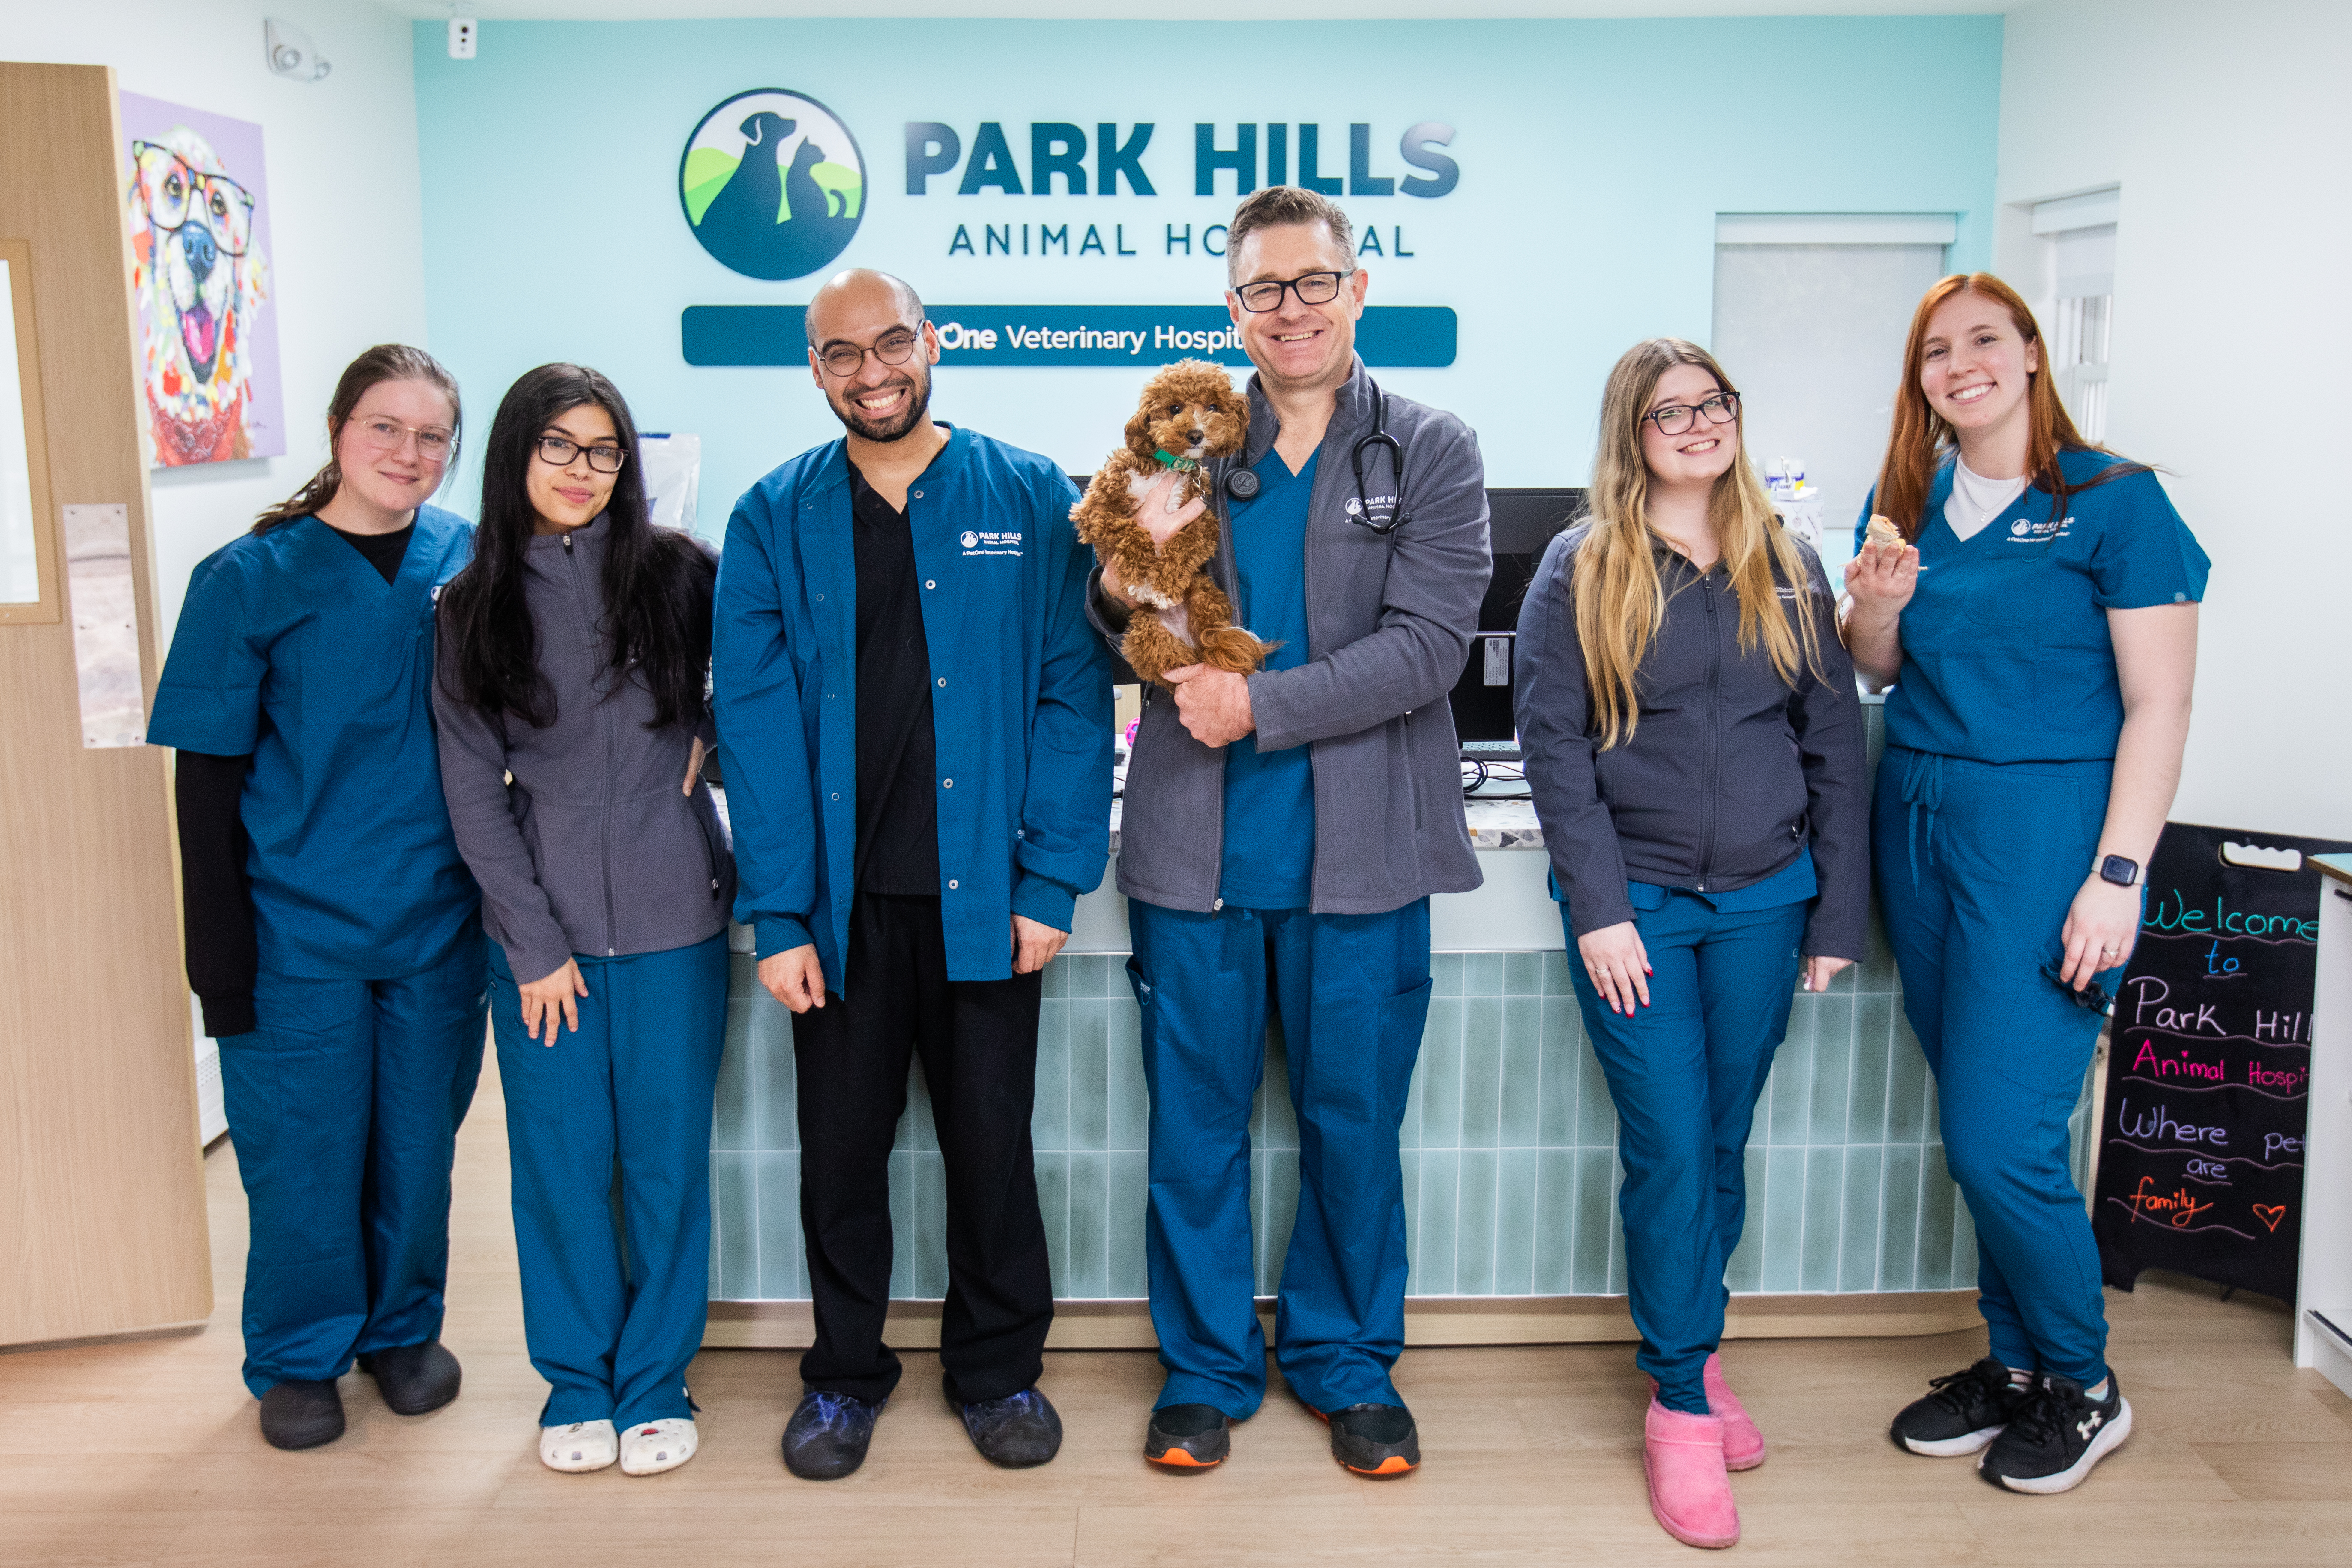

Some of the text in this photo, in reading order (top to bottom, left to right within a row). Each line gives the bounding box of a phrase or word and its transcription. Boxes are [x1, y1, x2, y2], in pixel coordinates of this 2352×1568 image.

[905, 122, 1459, 198] PARK HILLS
[949, 223, 1414, 257] ANIMAL HOAL
[1005, 325, 1147, 355] Veterinary
[1365, 496, 1385, 505] PARK
[1001, 532, 1022, 541] HILLS
[2143, 889, 2318, 941] Welcome
[2205, 940, 2240, 974] to
[2133, 1039, 2225, 1080] Animal
[2119, 1097, 2228, 1145] Where
[2186, 1159, 2228, 1178] are
[2129, 1176, 2214, 1227] family
